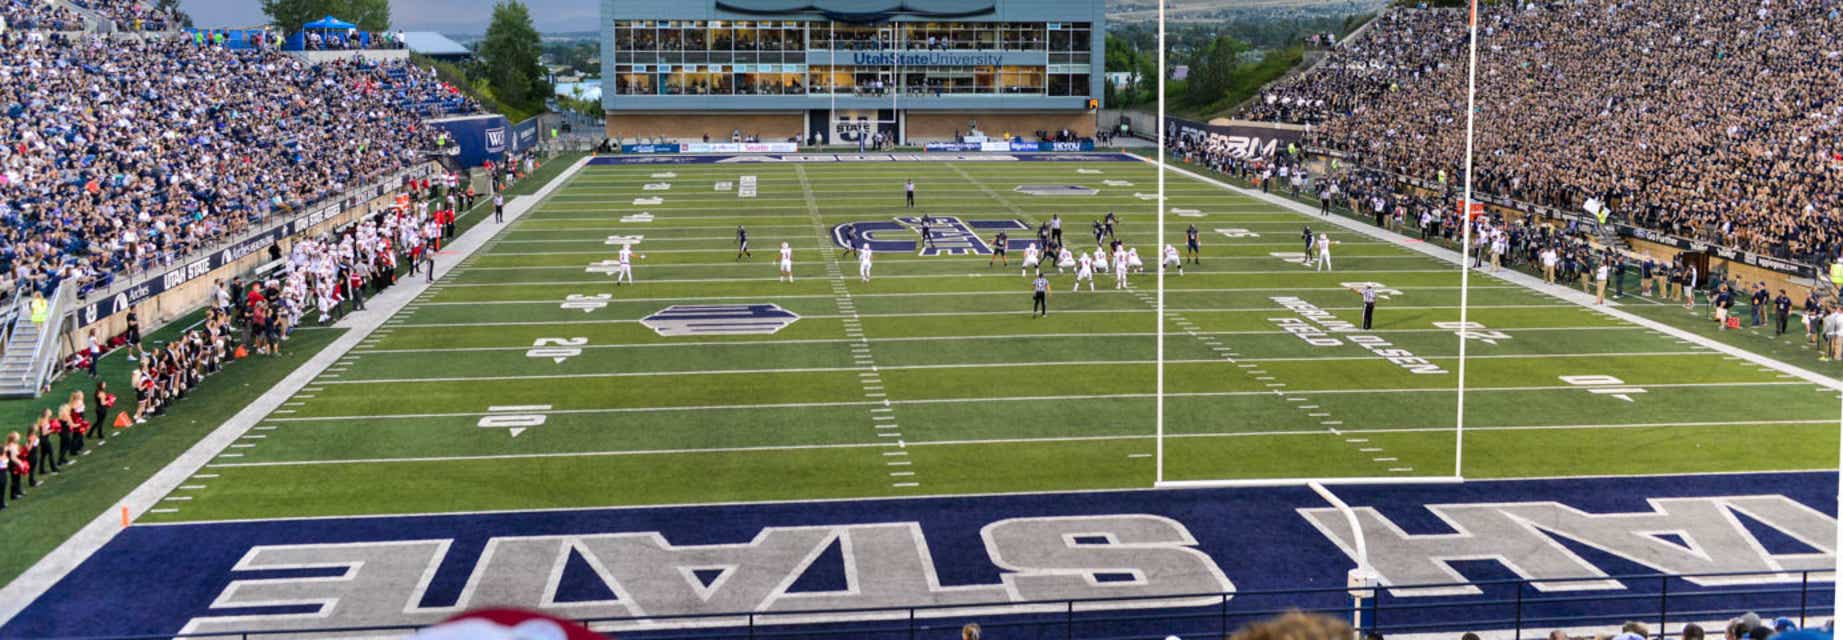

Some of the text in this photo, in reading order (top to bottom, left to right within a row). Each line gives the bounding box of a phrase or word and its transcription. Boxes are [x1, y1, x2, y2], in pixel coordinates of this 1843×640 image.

[163, 256, 211, 290] UTAH STATE
[1267, 317, 1345, 347] FIELD
[1431, 321, 1514, 340] 20
[526, 336, 589, 358] 20
[1345, 335, 1450, 375] OLSEN
[1557, 374, 1650, 395] 10
[477, 404, 553, 428] 10
[173, 514, 1240, 639] STATE
